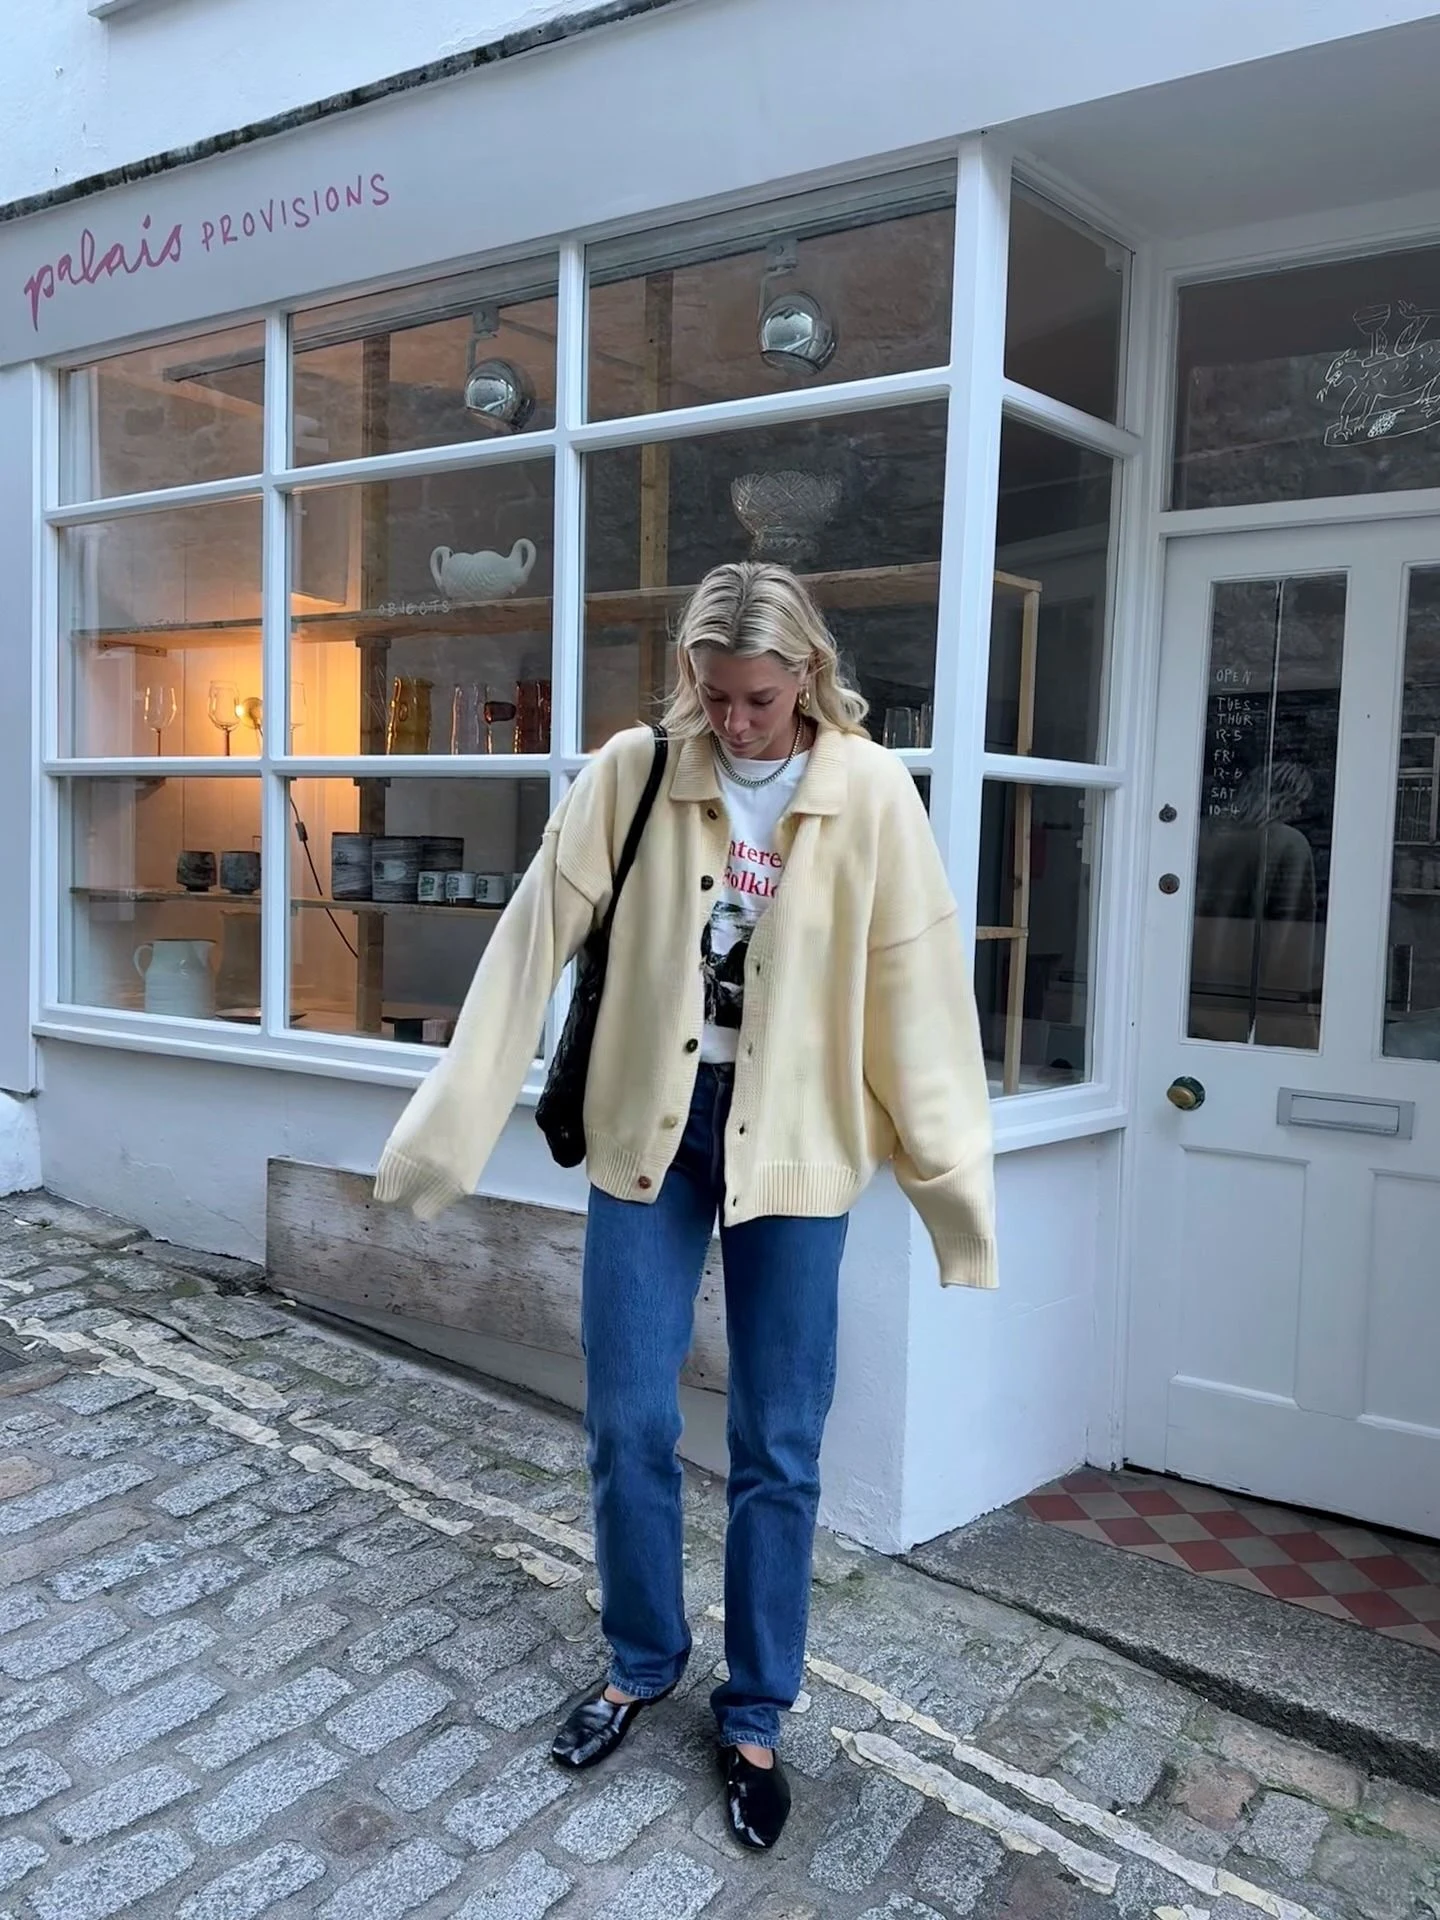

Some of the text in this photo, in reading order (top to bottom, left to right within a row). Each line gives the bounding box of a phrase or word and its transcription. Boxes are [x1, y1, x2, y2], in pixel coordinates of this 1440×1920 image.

[23, 173, 391, 332] palais PROVISIONS
[1216, 668, 1252, 685] OPEN
[1216, 713, 1254, 727] THUR
[1213, 749, 1236, 763] FRI
[1210, 787, 1237, 800] SAT
